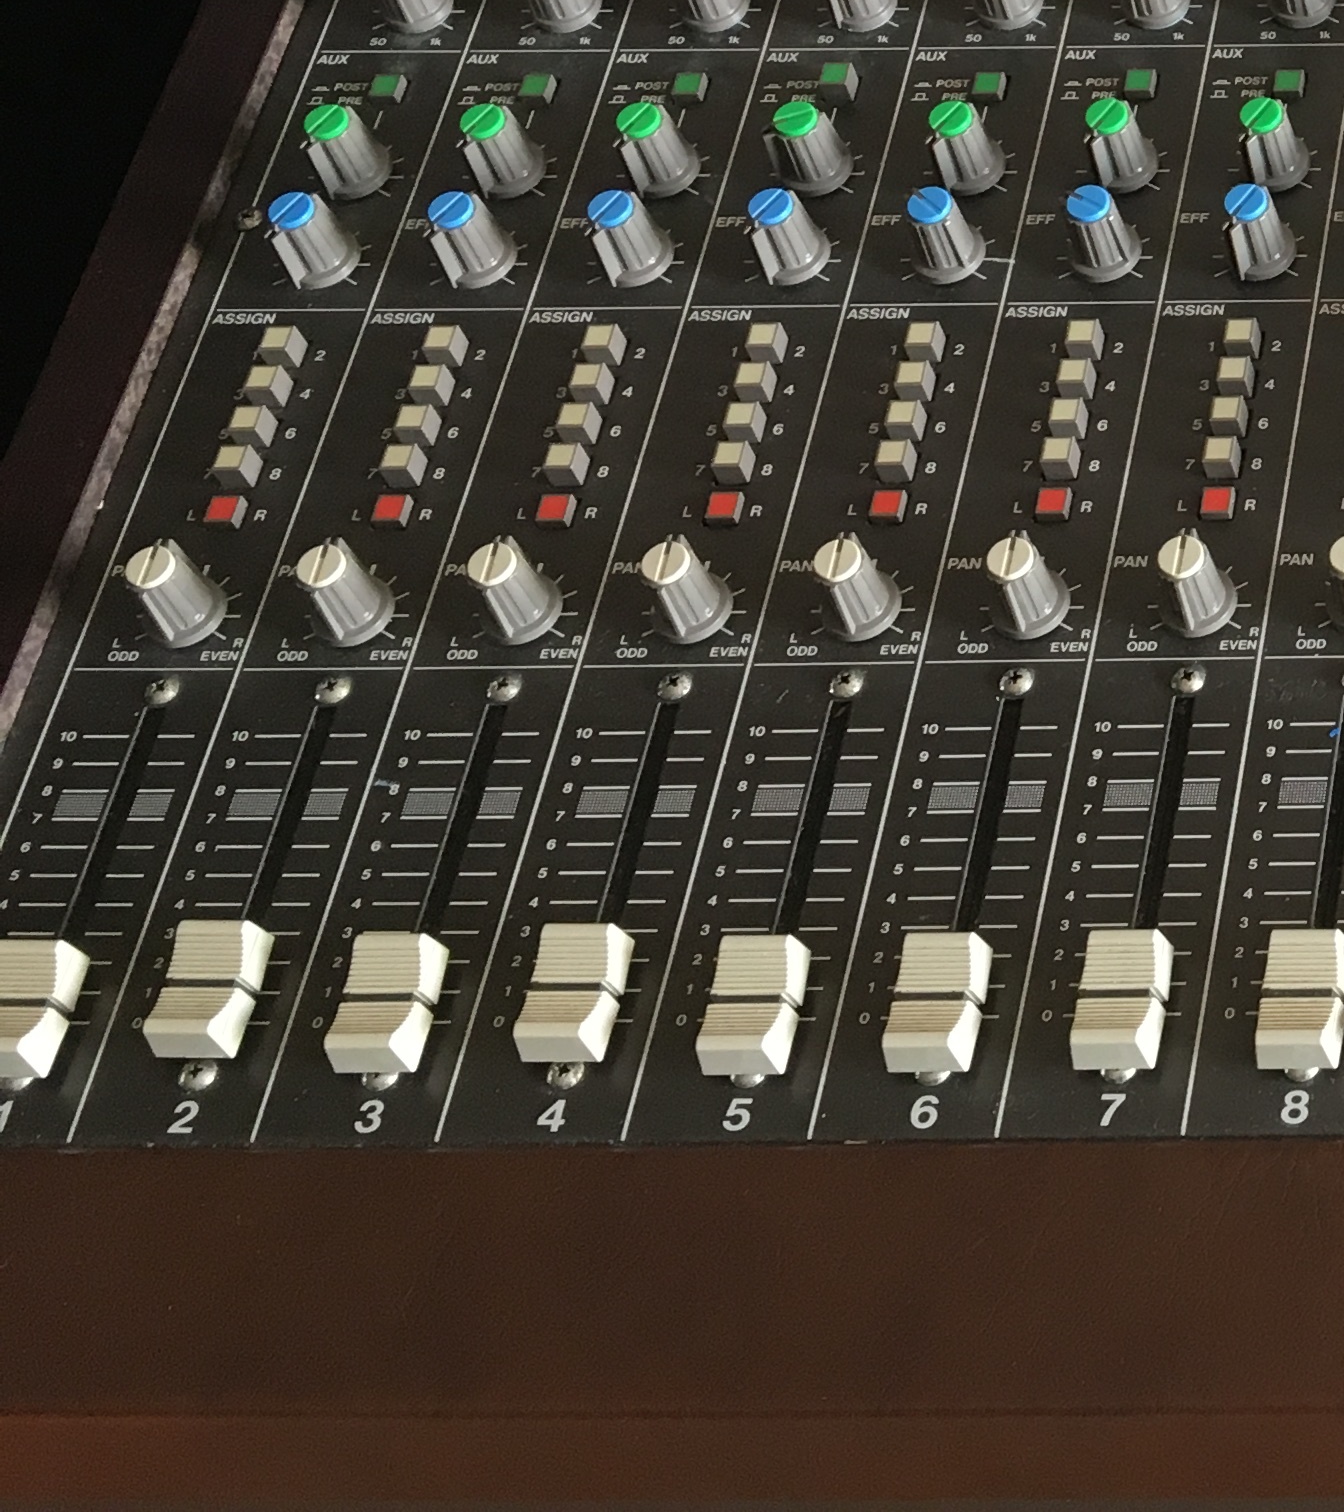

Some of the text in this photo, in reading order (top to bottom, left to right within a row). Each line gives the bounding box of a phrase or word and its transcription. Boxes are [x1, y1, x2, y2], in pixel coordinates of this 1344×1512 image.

[316, 54, 349, 66] AUX
[466, 54, 499, 65] AUX
[616, 53, 649, 64] AUX
[766, 51, 798, 63] AUX
[915, 51, 947, 62] AUX
[1064, 49, 1096, 61] AUX
[1212, 48, 1243, 59] AUX
[688, 310, 752, 322] ASSIGN
[846, 307, 910, 320] ASSIGN
[1005, 306, 1068, 319] ASSIGN
[1162, 304, 1225, 317] ASSIGN
[212, 313, 276, 326] ASSIGN
[371, 312, 434, 325] ASSIGN
[529, 311, 593, 324] ASSIGN
[911, 1095, 939, 1129] 6
[1100, 1094, 1126, 1126] 7
[1281, 1090, 1309, 1124] 8
[167, 1101, 199, 1133] 2
[355, 1100, 384, 1133] 3
[537, 1100, 566, 1132] 4
[723, 1098, 753, 1131] 5
